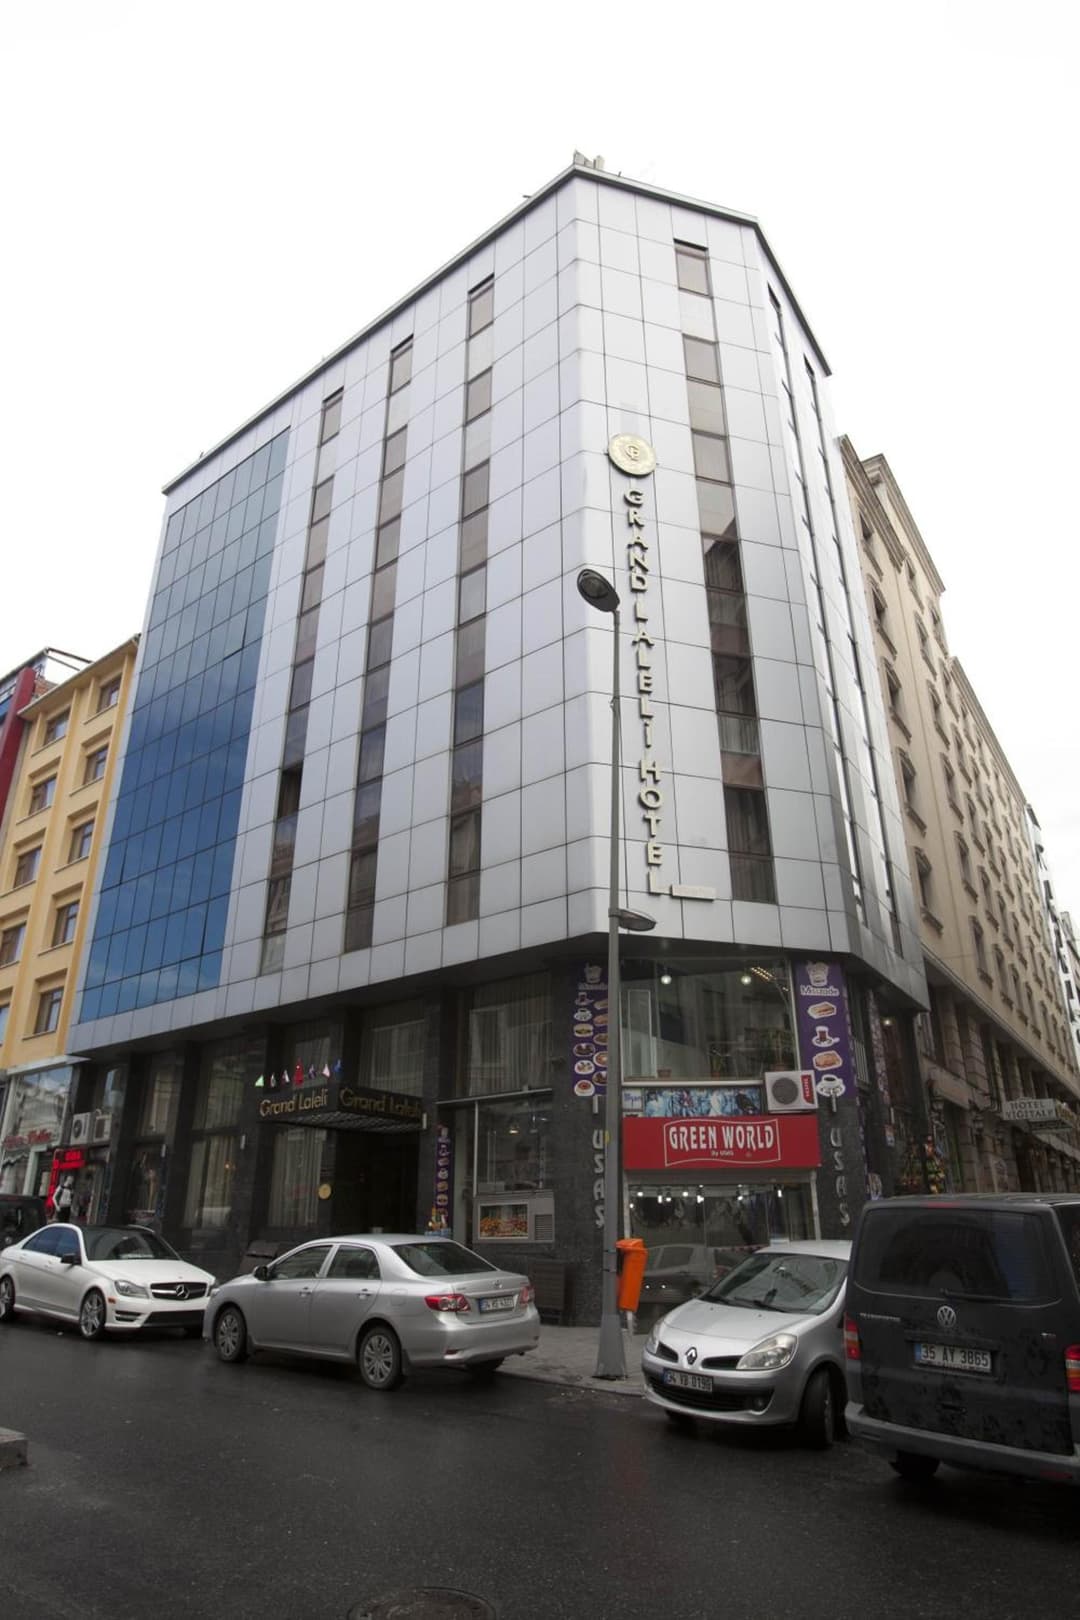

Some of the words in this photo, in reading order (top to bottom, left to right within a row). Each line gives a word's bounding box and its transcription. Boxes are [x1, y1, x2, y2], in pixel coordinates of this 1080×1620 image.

[623, 489, 651, 594] GRAND
[638, 758, 672, 896] HOTEL
[260, 1093, 298, 1117] Grand
[299, 1088, 328, 1110] Laleli
[339, 1087, 386, 1112] Grand
[1010, 1101, 1046, 1110] HOTEL
[669, 1126, 718, 1152] GREEN
[721, 1125, 774, 1152] WORLD
[829, 1127, 851, 1227] USAS
[921, 1344, 936, 1360] 35
[941, 1347, 955, 1362] AY
[960, 1350, 989, 1367] 3865
